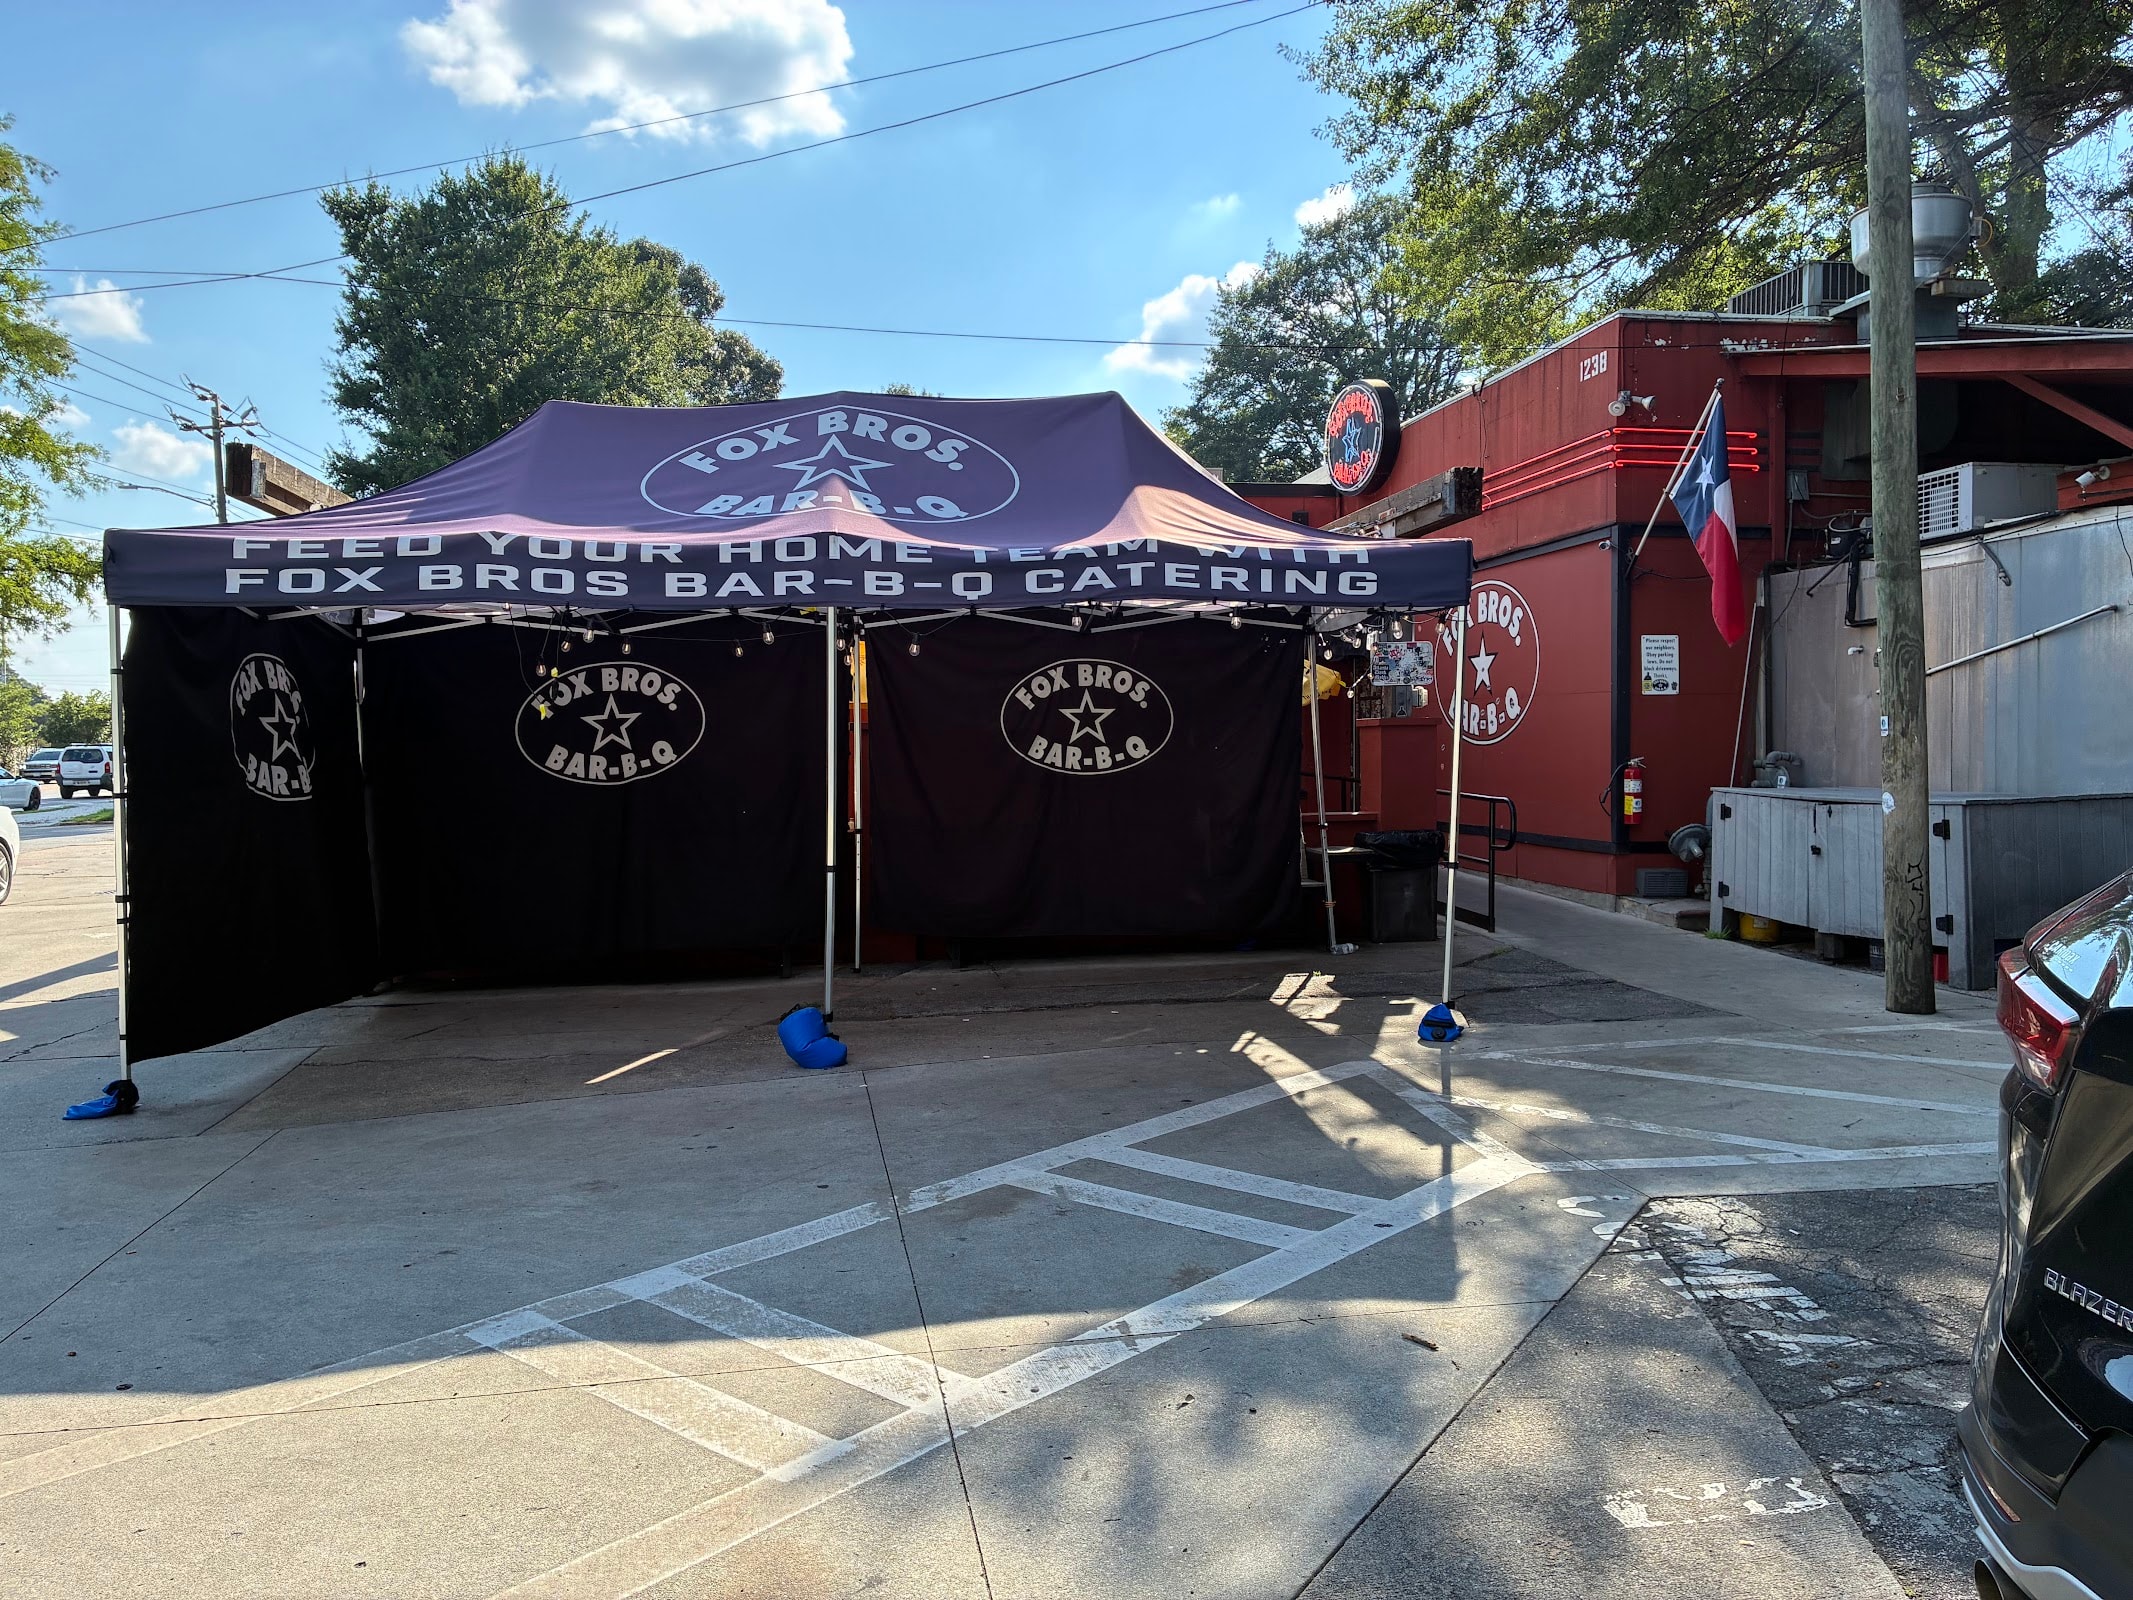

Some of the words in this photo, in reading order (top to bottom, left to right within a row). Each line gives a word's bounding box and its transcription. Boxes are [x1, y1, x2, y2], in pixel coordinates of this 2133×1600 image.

[1580, 350, 1608, 382] 1238
[679, 421, 800, 474] FOX
[818, 411, 969, 471] BROS.
[695, 489, 968, 519] BAR-B-Q
[232, 534, 442, 559] FEED
[478, 531, 684, 563] YOUR
[718, 534, 934, 563] HOME
[959, 538, 1159, 563] TEAM
[225, 566, 384, 594] FOX
[418, 563, 629, 596] BROS
[665, 570, 994, 600] BAR-B-Q
[1025, 562, 1378, 596] CATERING
[1477, 590, 1523, 647] BROS.
[236, 660, 264, 716] FOX
[263, 660, 302, 725] BRS.
[531, 671, 594, 719] FOX
[601, 667, 681, 711] BROS.
[1015, 665, 1071, 710] FOX
[1077, 663, 1150, 709] BROS.
[545, 740, 677, 780] BAR-B-Q
[1027, 735, 1150, 770] BAR-B-Q
[2044, 1267, 2133, 1333] BLAZER
